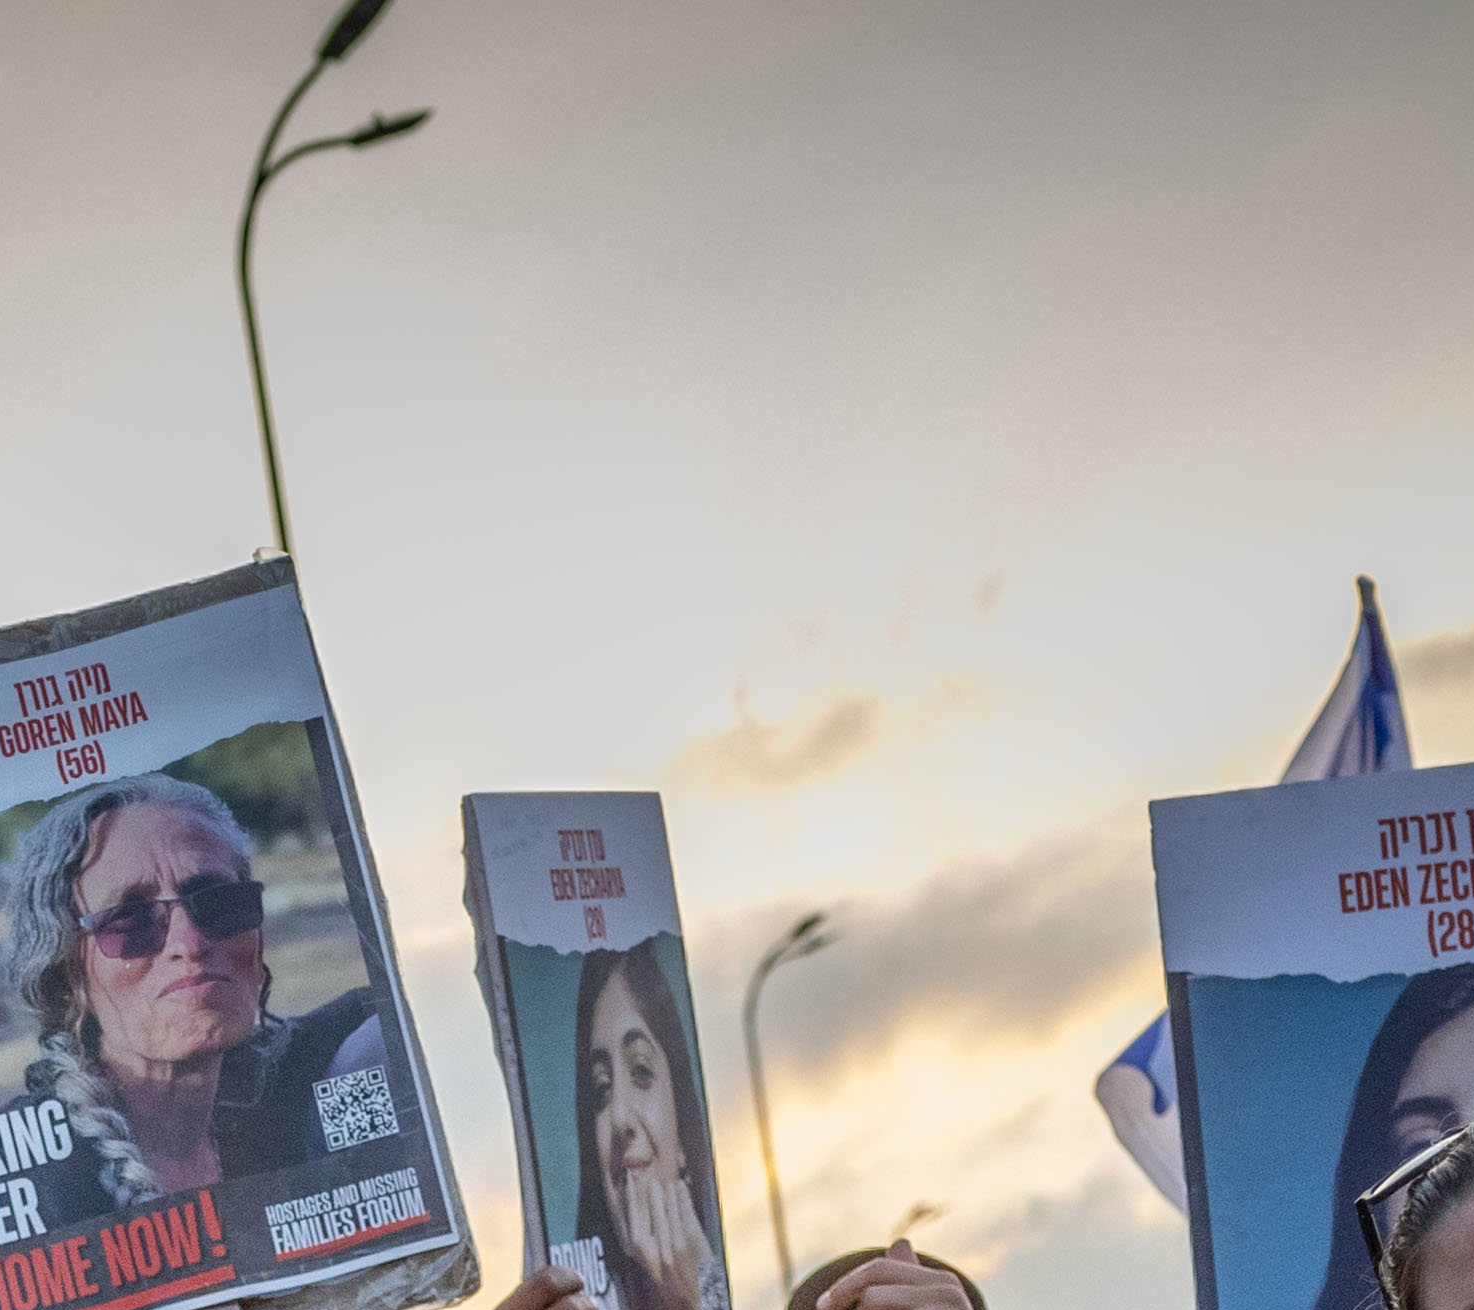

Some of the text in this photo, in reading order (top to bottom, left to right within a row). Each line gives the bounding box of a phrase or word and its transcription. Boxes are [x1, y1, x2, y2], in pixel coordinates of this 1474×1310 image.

[13, 661, 112, 718] מיה גורן
[78, 690, 149, 738] MAYA
[56, 739, 106, 785] (56)
[1377, 811, 1458, 860] זכריה
[1338, 866, 1411, 914] EDEN
[265, 1166, 419, 1227] HOSTAGES MISSING
[270, 1186, 427, 1255] FAMILIES FORUM
[99, 1190, 227, 1287] NOW!
